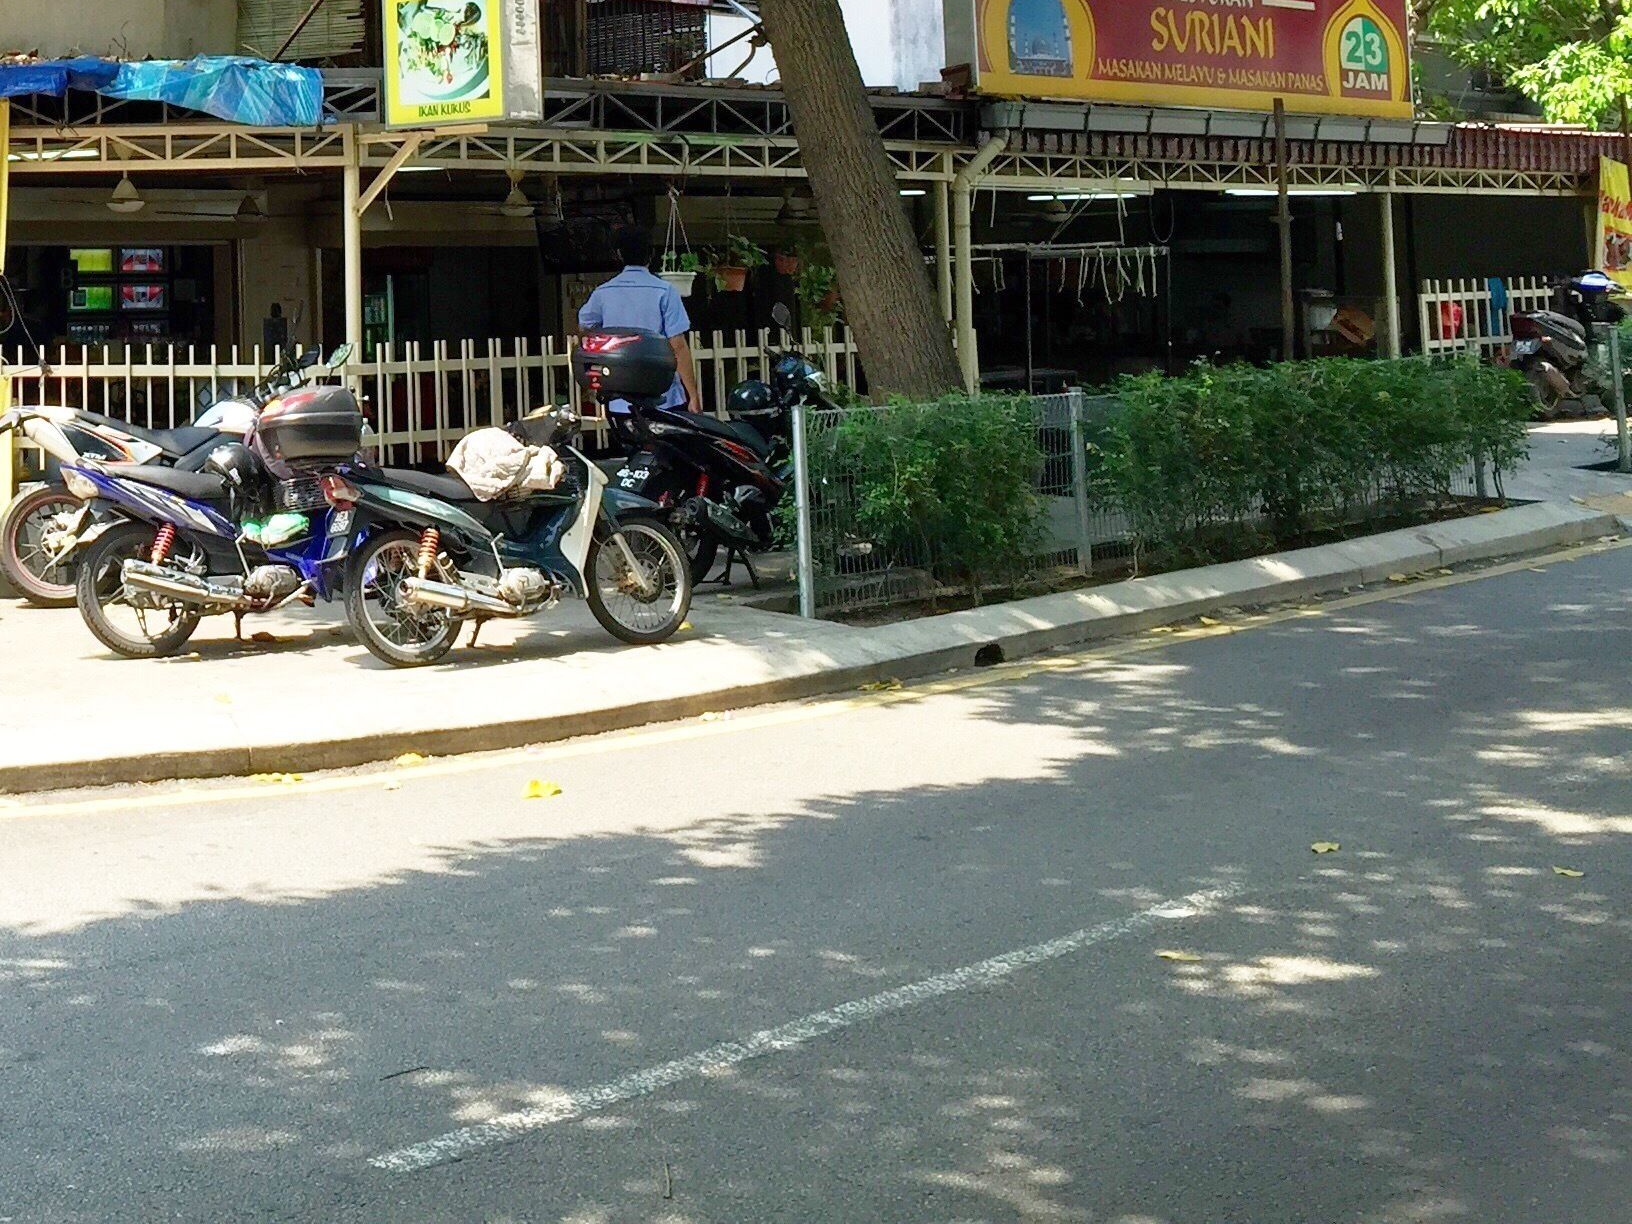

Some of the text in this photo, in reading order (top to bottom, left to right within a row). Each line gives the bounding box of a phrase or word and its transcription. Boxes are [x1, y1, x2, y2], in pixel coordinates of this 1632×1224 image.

[1150, 6, 1275, 59] SURIANI
[1344, 30, 1384, 66] 23
[1097, 57, 1324, 91] MASAKAN MELAYU & MASAKAN PANAS
[1342, 71, 1388, 92] JAM
[418, 101, 471, 117] IKAN KUKUS
[620, 478, 636, 488] DC
